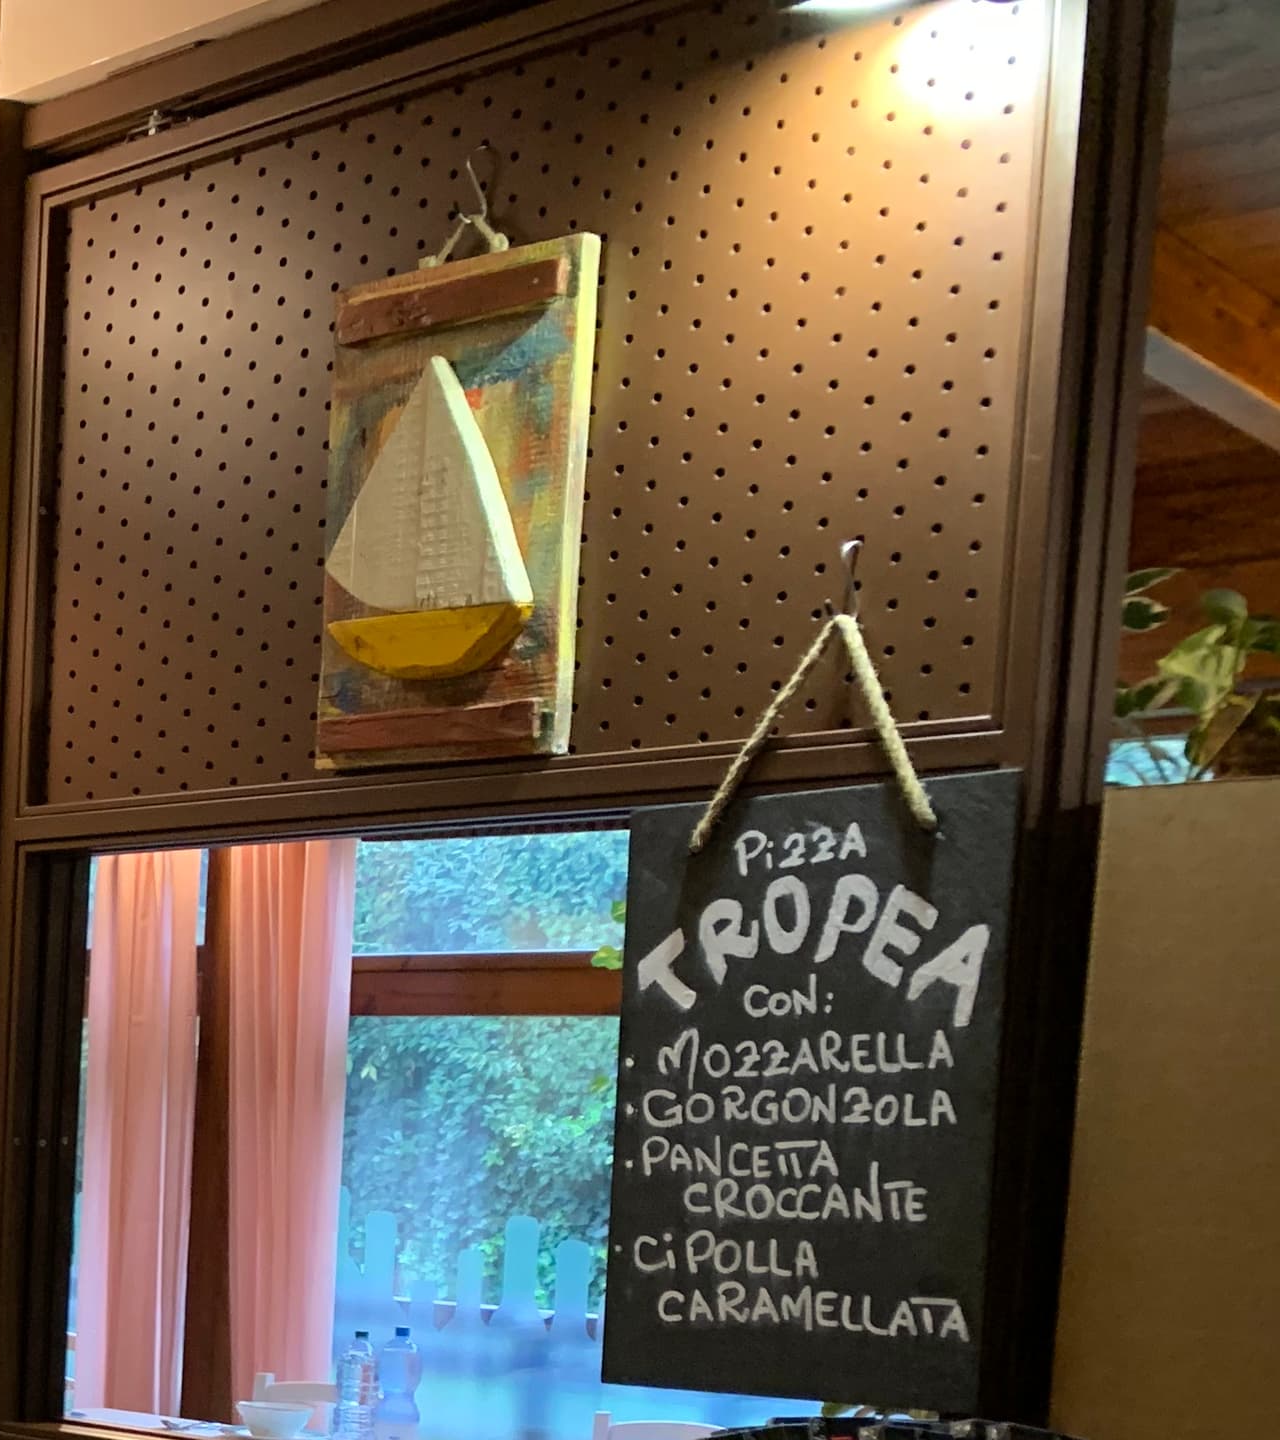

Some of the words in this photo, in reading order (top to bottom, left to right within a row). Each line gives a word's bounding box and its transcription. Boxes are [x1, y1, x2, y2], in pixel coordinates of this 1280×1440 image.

[638, 873, 991, 1028] TROPEA
[657, 1029, 956, 1089] MOZZARELLA
[642, 1087, 959, 1129] GORGONZOLA
[642, 1135, 839, 1178] PANCETTA
[683, 1162, 929, 1222] CROCCANTE
[657, 1281, 971, 1343] CARAMELLATA
